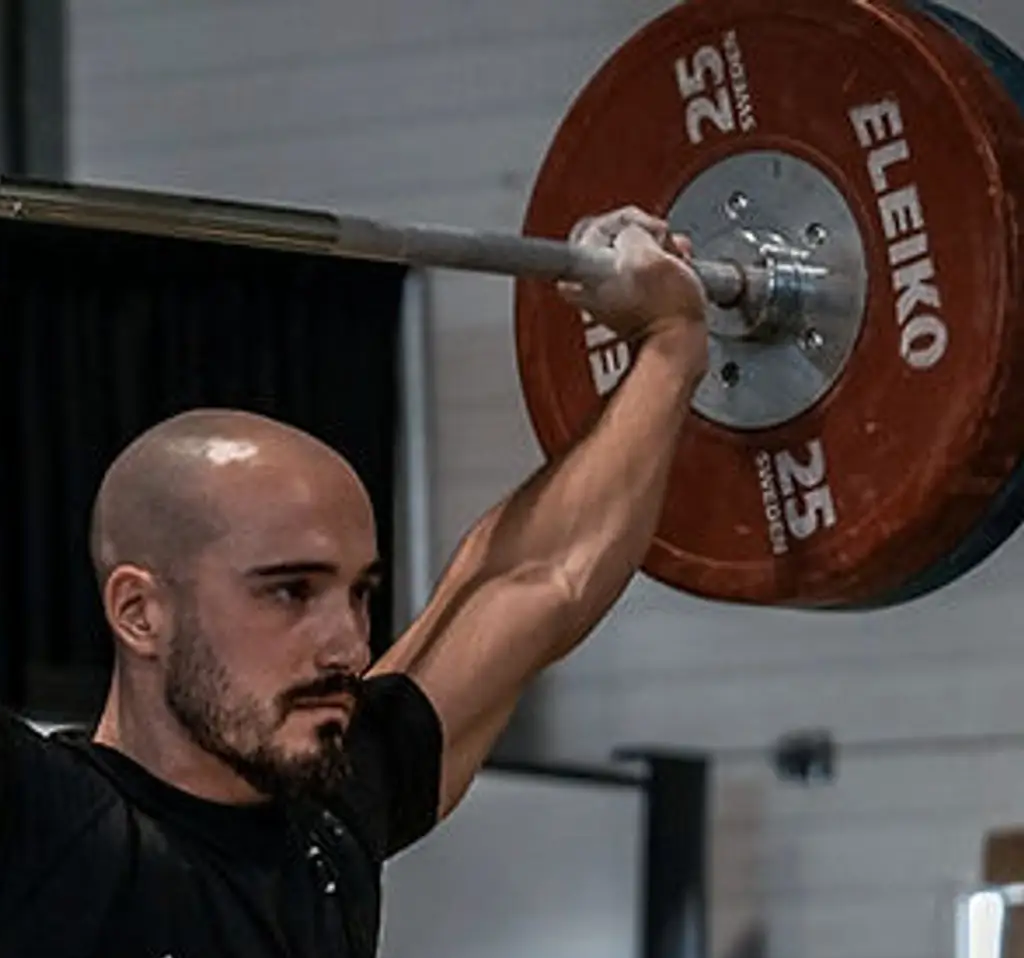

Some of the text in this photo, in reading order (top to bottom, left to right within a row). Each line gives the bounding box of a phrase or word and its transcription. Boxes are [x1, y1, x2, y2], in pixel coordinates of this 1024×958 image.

[675, 44, 735, 144] 25
[849, 98, 948, 370] ELEIKO
[775, 438, 837, 539] 25
